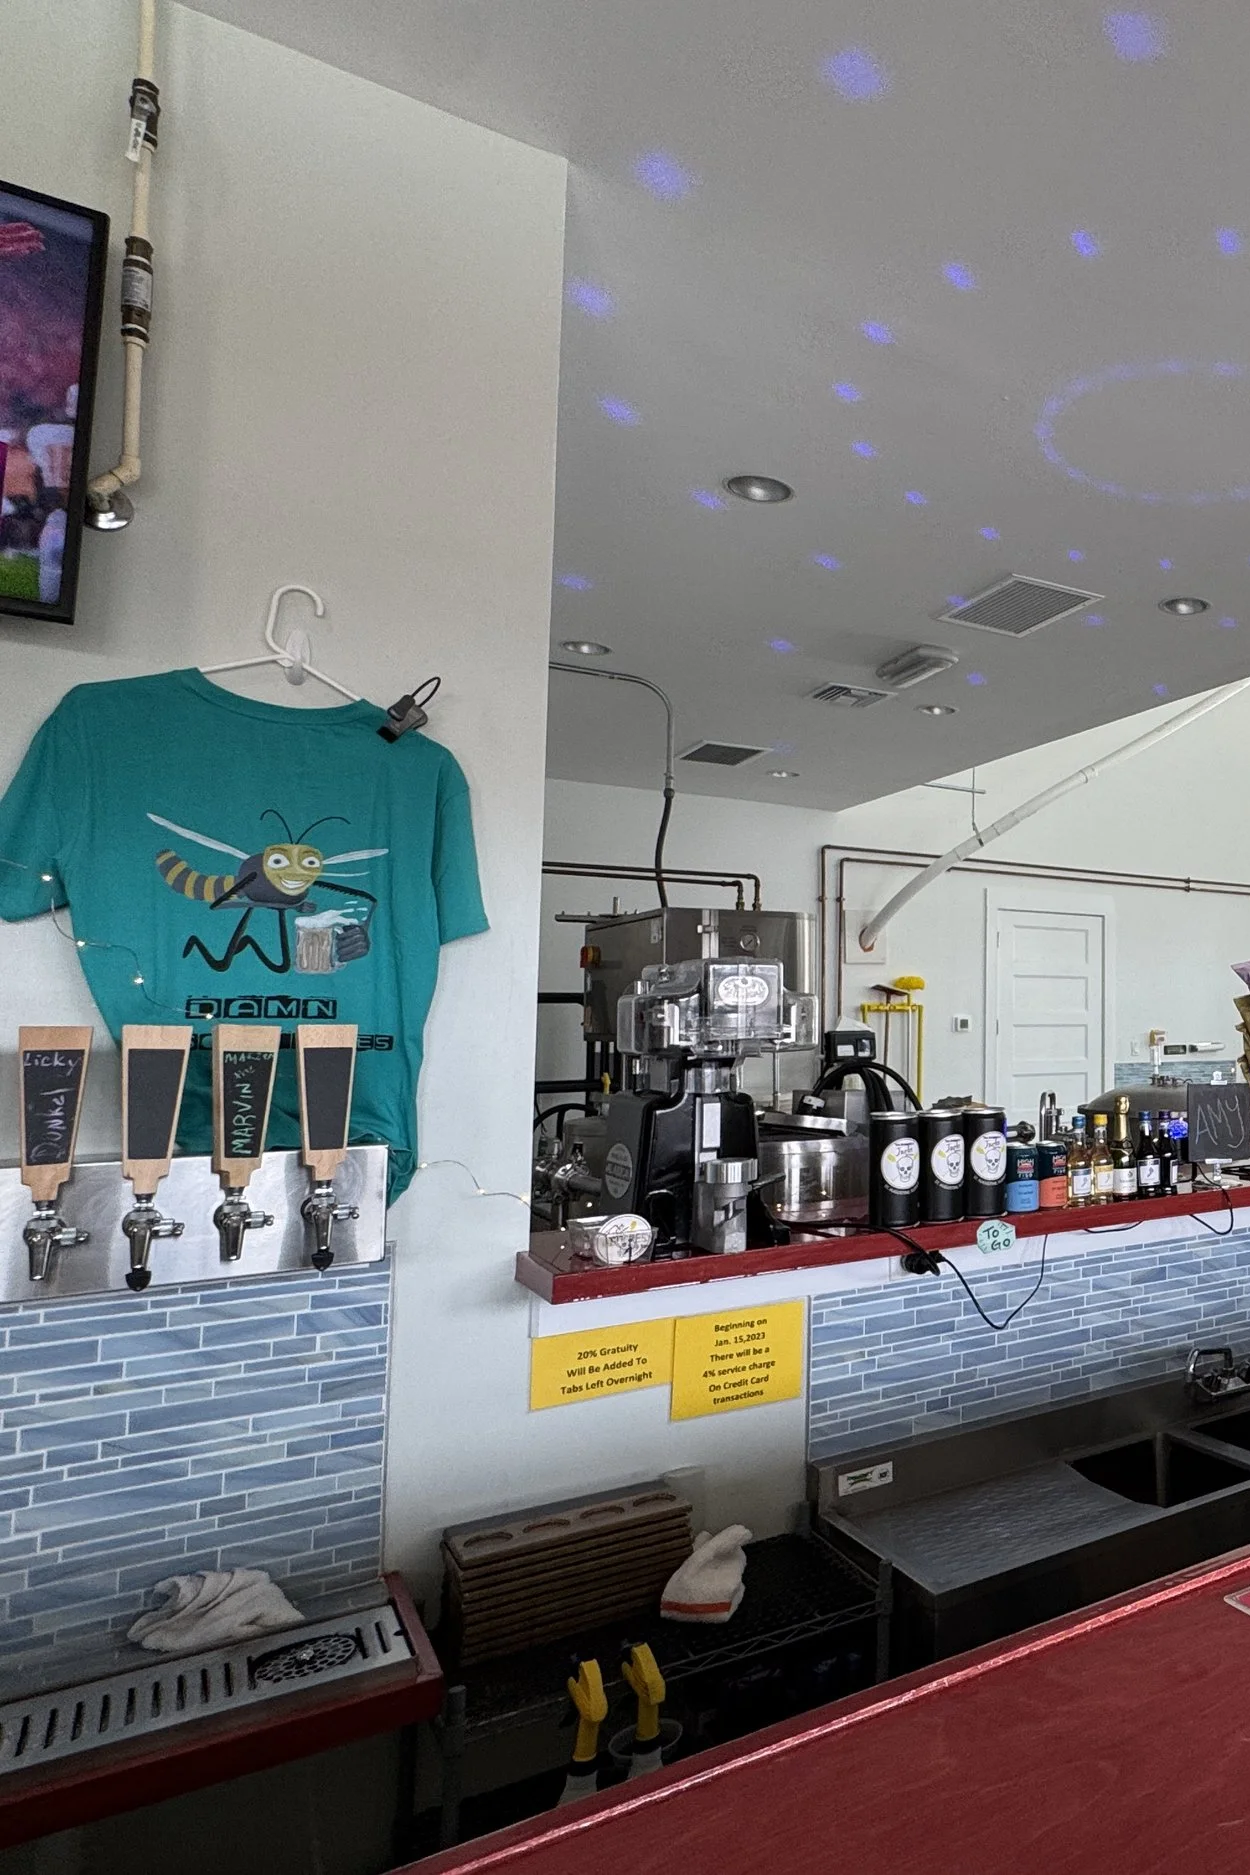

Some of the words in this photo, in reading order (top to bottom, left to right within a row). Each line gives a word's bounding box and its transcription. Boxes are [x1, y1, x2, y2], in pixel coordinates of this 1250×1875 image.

[187, 998, 337, 1019] DAMN
[231, 1083, 257, 1155] MARVIN
[982, 1226, 1000, 1240] TO
[991, 1238, 1011, 1251] GO
[714, 1320, 755, 1332] Beginning
[756, 1318, 768, 1326] on
[714, 1339, 731, 1347] Jan.
[733, 1332, 766, 1344] 15,2023
[577, 1349, 597, 1361] 20%
[600, 1344, 639, 1356] Gratuity
[710, 1352, 734, 1362] There
[736, 1348, 751, 1358] will
[752, 1347, 763, 1356] be
[566, 1366, 586, 1378] Will
[588, 1365, 601, 1374] Be
[603, 1358, 634, 1372] Added
[636, 1356, 648, 1365] To
[702, 1369, 716, 1378] 4%
[717, 1365, 747, 1376] service
[748, 1360, 776, 1370] charge
[560, 1384, 583, 1395] Tabs
[585, 1379, 604, 1391] Left
[606, 1371, 653, 1387] Overnight
[709, 1384, 721, 1393] On
[723, 1379, 749, 1390] Credit
[750, 1374, 769, 1384] Card
[713, 1389, 764, 1405] transactions
